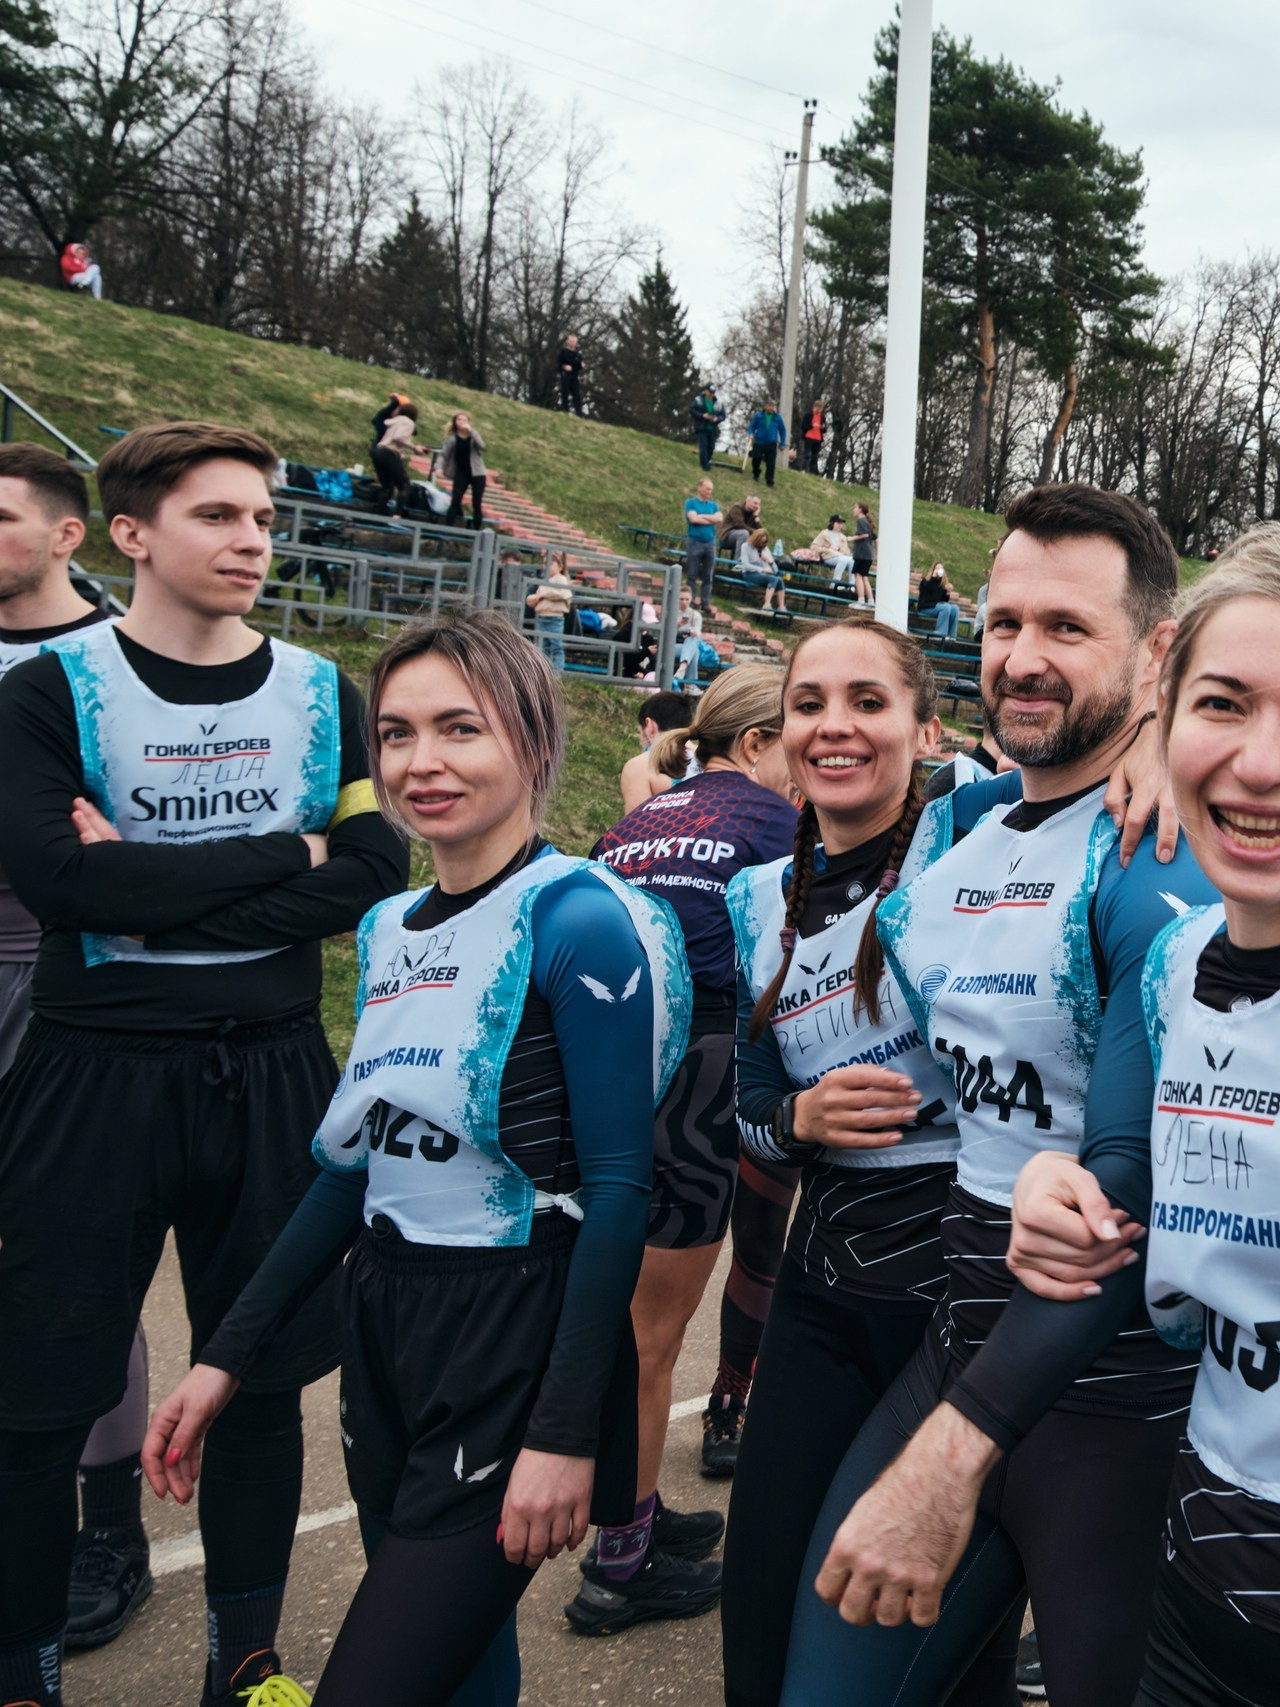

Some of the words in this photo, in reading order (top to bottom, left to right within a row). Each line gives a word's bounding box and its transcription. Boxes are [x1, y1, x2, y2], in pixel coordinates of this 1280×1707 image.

[144, 744, 200, 757] ГОНКА
[203, 738, 271, 756] ГЕРОЕВ
[130, 786, 279, 822] Sminex
[642, 798, 692, 811] ГЕРОЕВ
[654, 790, 696, 802] ГОНКА
[652, 874, 727, 895] НАДЕЖНОСТЬ
[1000, 882, 1056, 901] ГЕРОЕВ
[402, 966, 460, 991] ГЕРОЕВ
[948, 973, 1037, 996] ГАЗПРОМБАНК
[353, 1047, 444, 1083] ГАЗПРОМБАНК
[1158, 1079, 1202, 1106] ГОНКА
[1155, 1112, 1254, 1190] ЛЕНА
